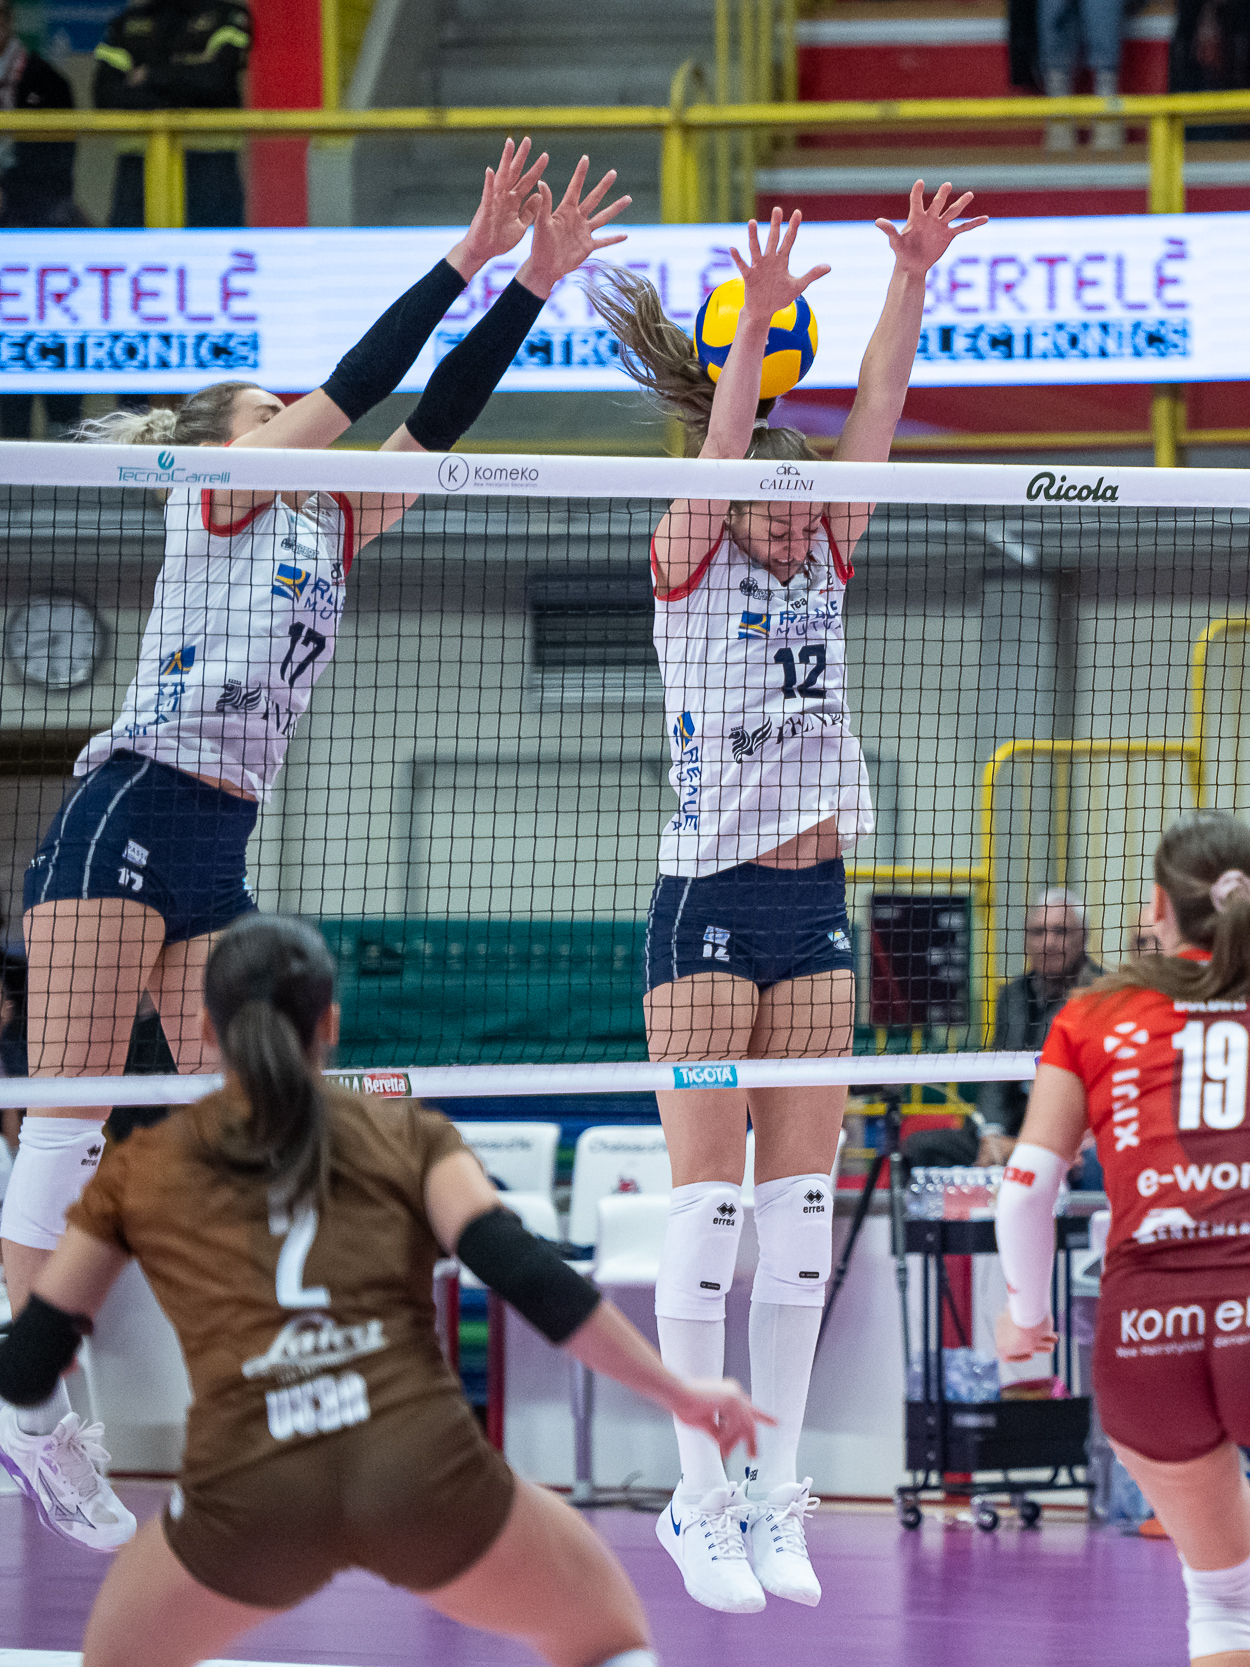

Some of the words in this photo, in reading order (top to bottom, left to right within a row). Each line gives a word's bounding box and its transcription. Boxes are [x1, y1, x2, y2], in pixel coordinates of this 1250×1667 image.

[0, 249, 257, 323] ERTELÈ
[0, 331, 259, 371] ECTRONICS
[760, 479, 814, 491] CALLINI
[1026, 471, 1119, 502] Ricola
[280, 621, 326, 689] 17
[774, 644, 827, 700] 12
[362, 1076, 406, 1094] Beretta
[1171, 1019, 1249, 1131] 19
[713, 1217, 735, 1226] errea
[803, 1205, 825, 1214] errea
